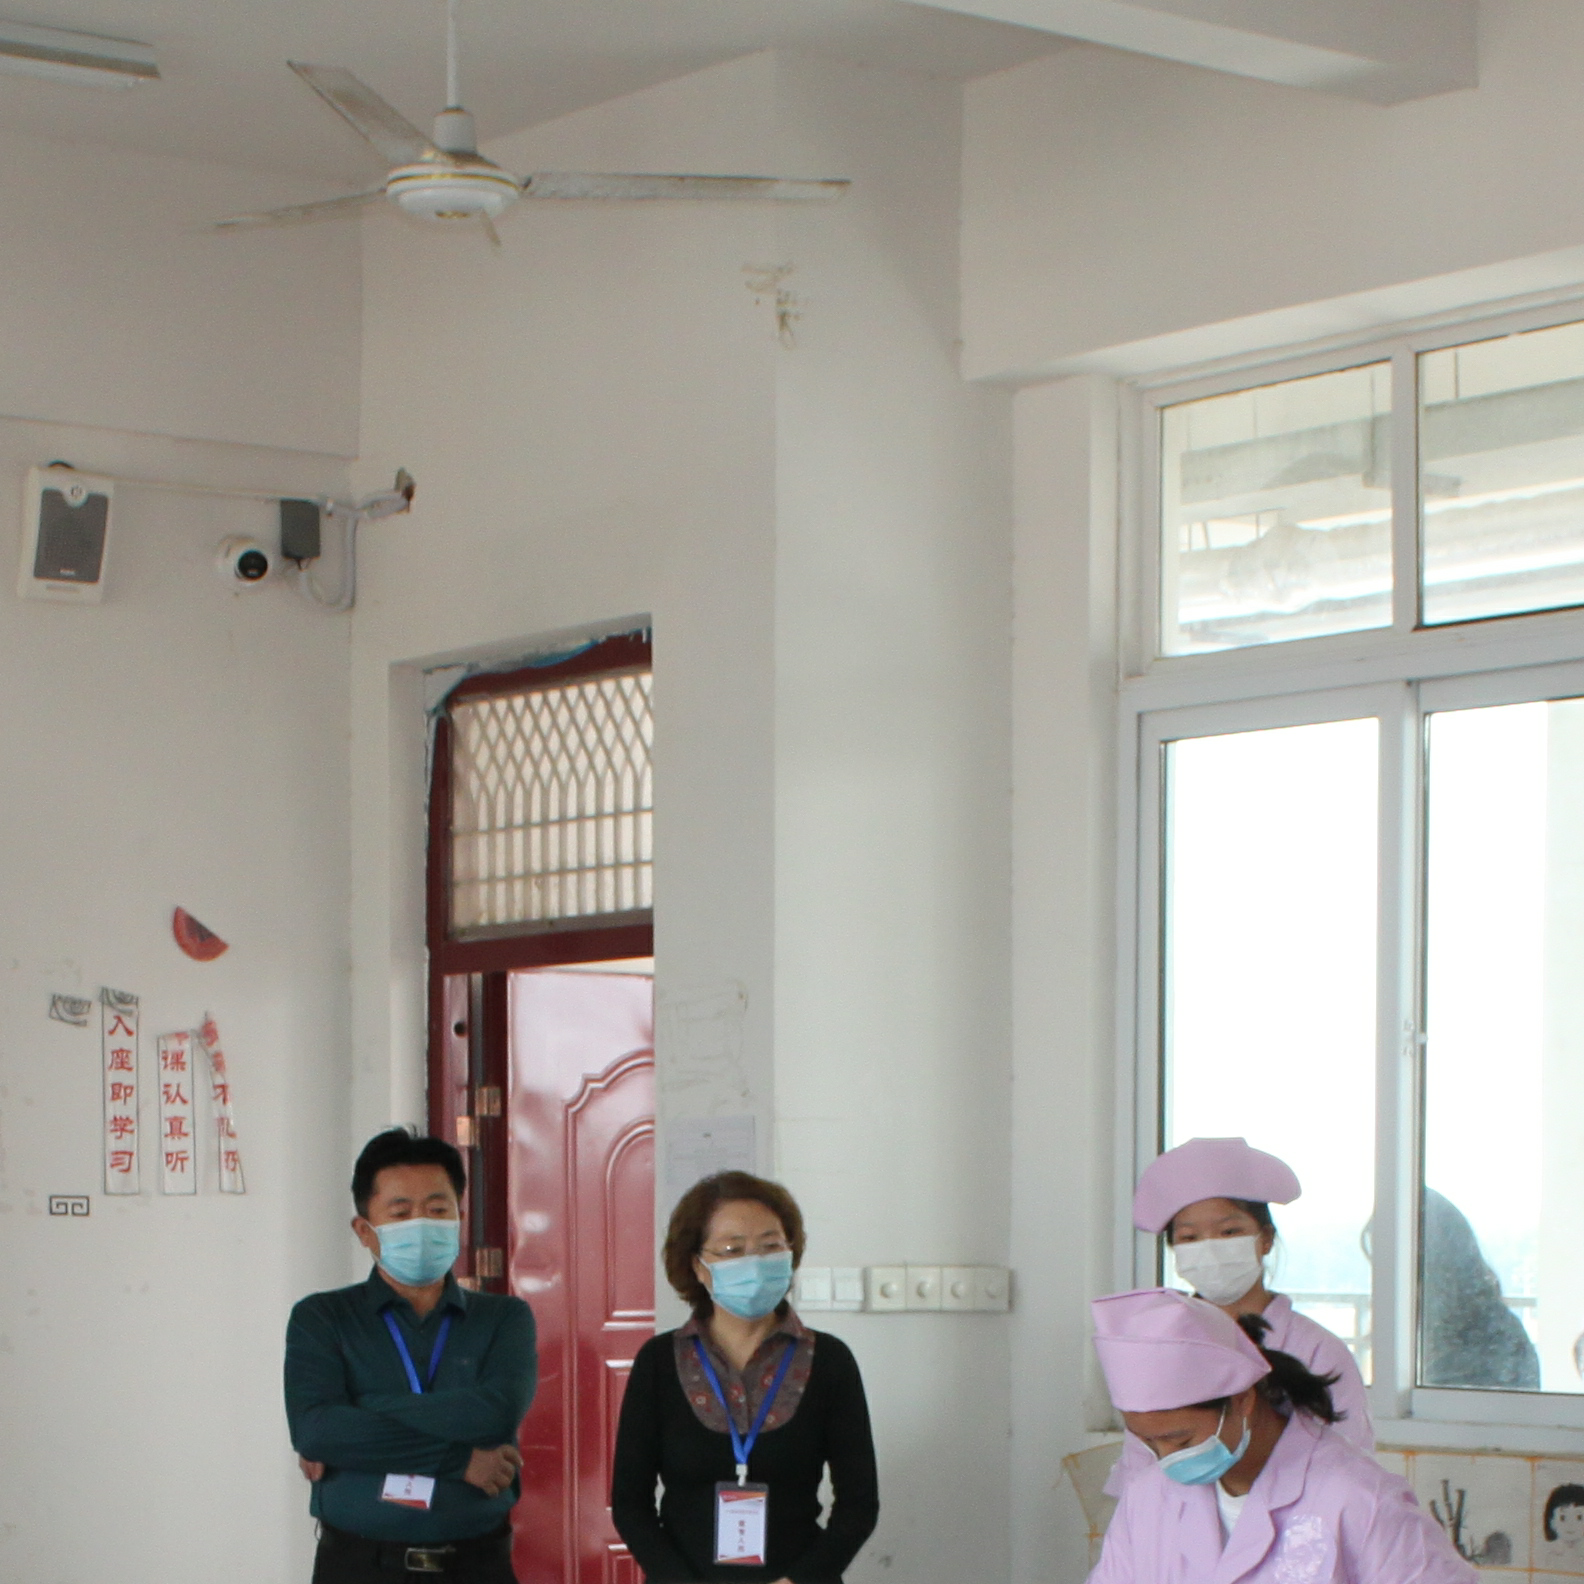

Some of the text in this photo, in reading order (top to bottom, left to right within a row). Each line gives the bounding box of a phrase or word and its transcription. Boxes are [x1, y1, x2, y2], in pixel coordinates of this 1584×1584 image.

[108, 1015, 135, 1173] 入座即学习
